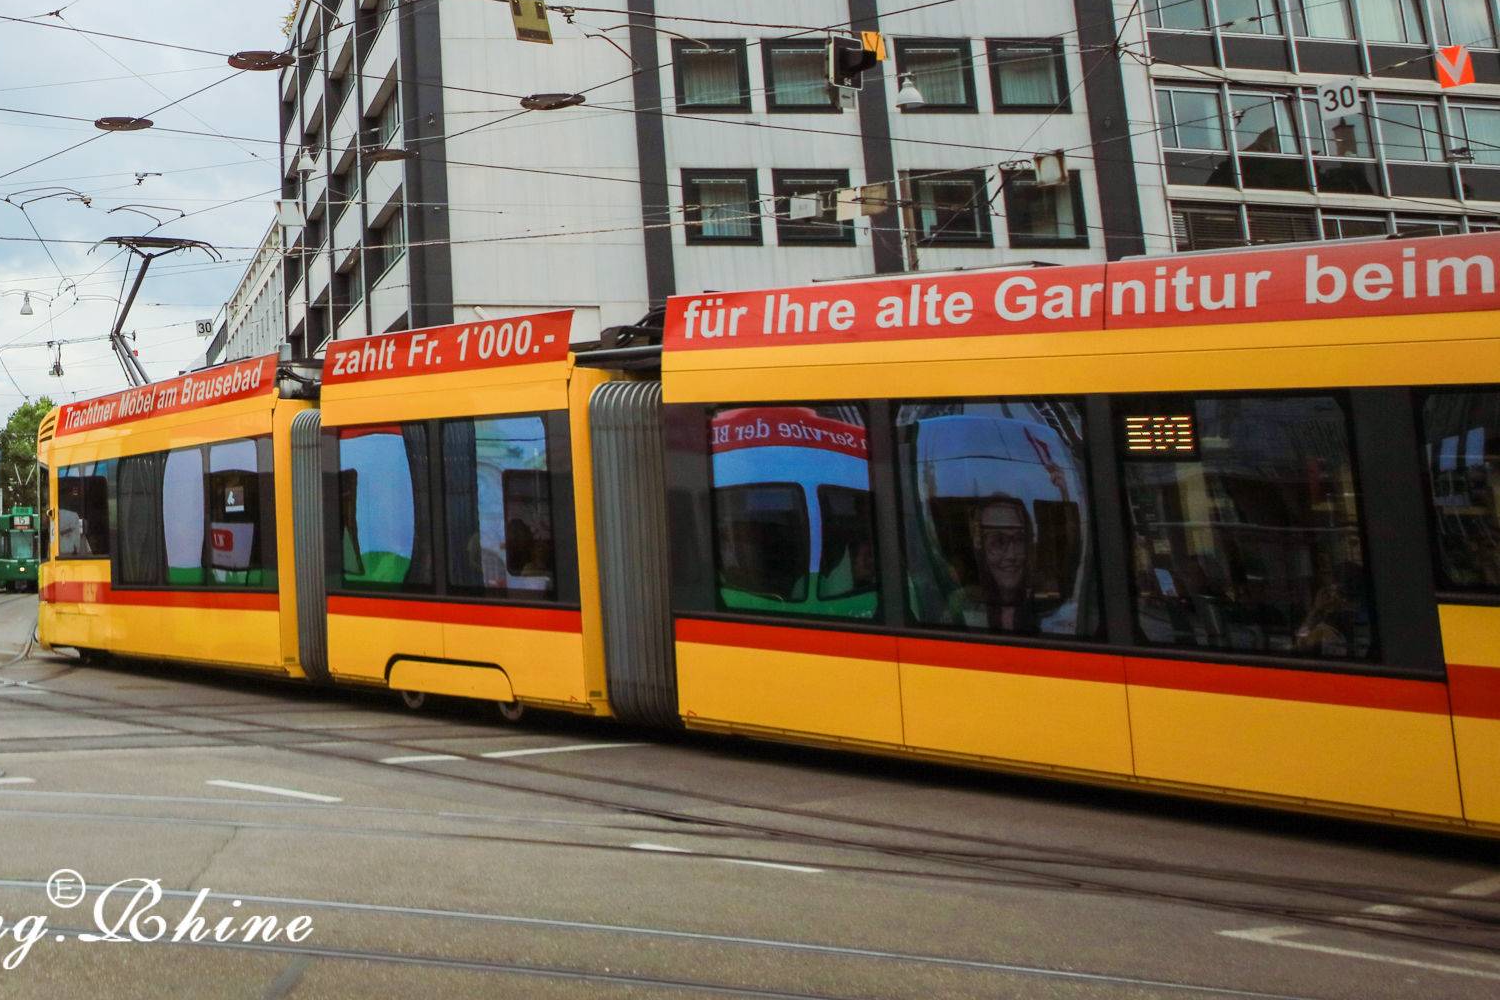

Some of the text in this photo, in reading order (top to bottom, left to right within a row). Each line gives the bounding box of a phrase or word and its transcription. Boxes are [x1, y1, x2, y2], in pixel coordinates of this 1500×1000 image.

[1323, 85, 1355, 112] 30
[683, 247, 1496, 339] für Ihre alte Garnitur beim
[198, 321, 212, 334] 30
[332, 338, 396, 376] zahlt
[407, 334, 442, 367] Fr.
[65, 360, 264, 430] Trachtner Möbel am Brausebad
